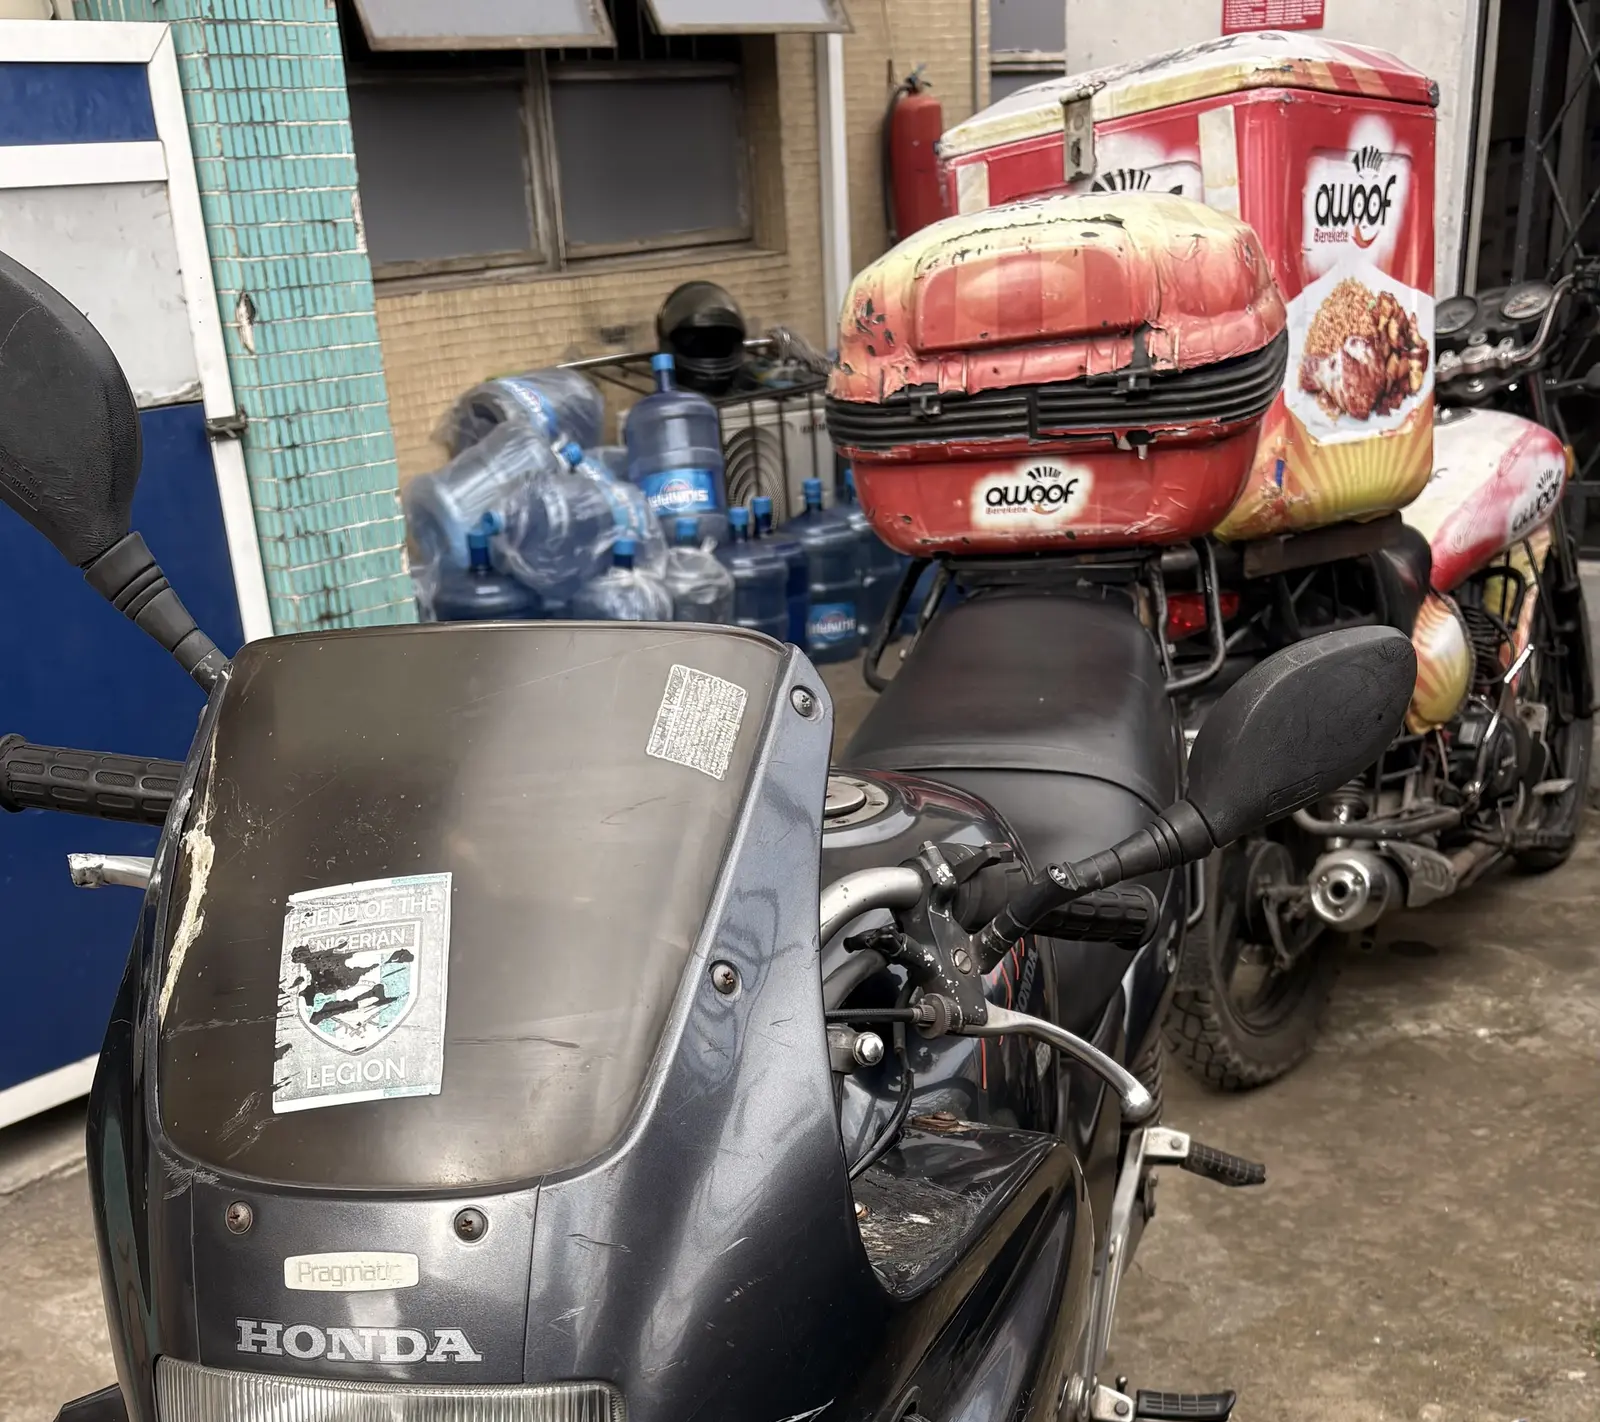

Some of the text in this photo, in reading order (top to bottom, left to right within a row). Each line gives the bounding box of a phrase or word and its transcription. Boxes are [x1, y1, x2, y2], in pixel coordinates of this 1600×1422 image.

[1315, 174, 1397, 227] awoof
[985, 478, 1079, 507] awoof
[288, 894, 440, 932] FRIEND OF THE
[315, 927, 406, 952] NIGERIAN
[1014, 947, 1039, 1013] ONDA
[305, 1055, 406, 1089] LEGION
[297, 1260, 402, 1287] Pragmatic
[236, 1318, 483, 1364] HONDA
